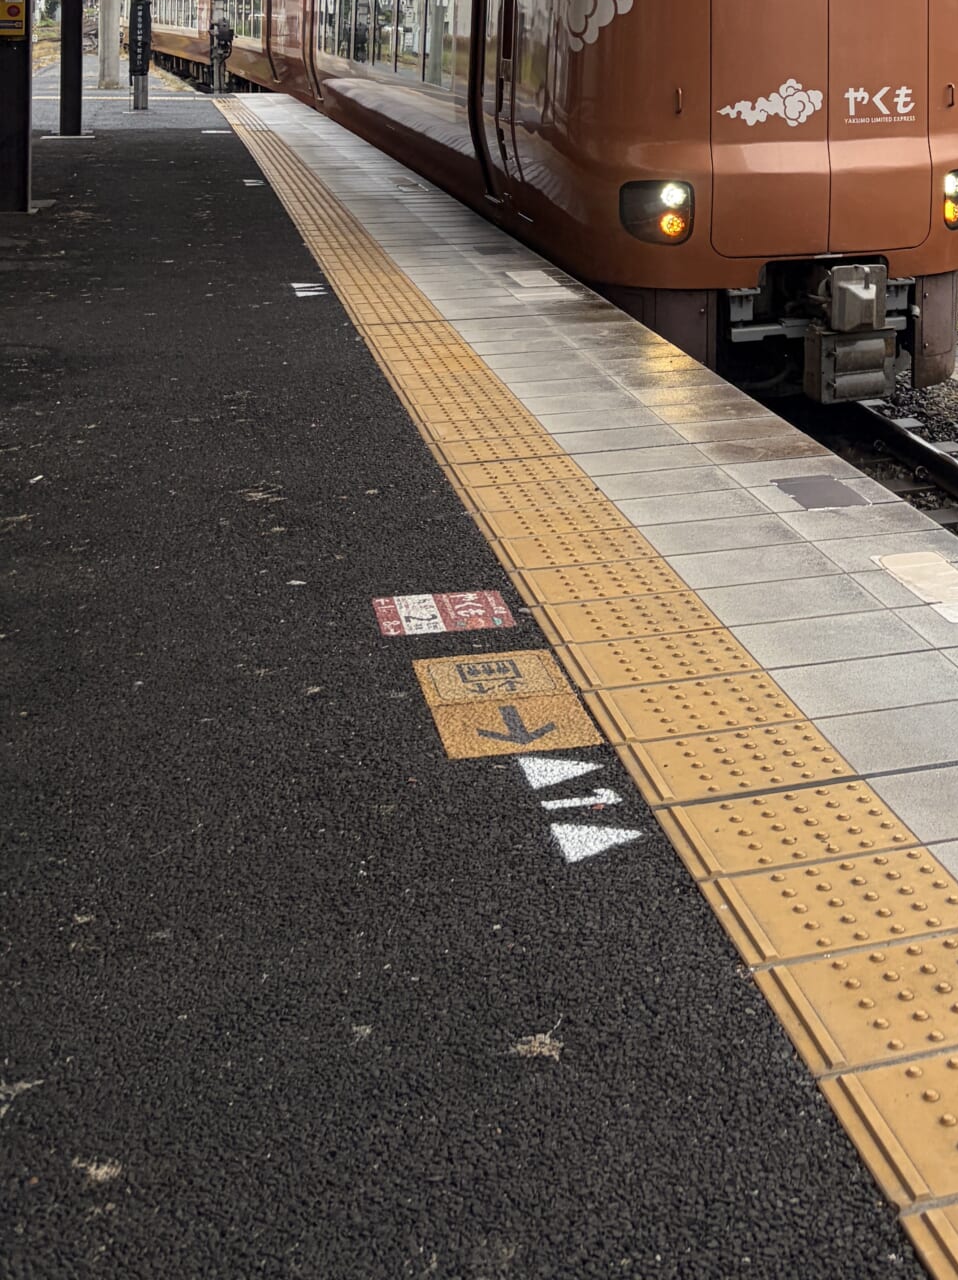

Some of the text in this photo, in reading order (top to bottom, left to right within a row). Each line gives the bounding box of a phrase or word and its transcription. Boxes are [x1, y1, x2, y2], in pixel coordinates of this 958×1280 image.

[844, 86, 916, 116] やくも
[449, 593, 486, 617] やくも
